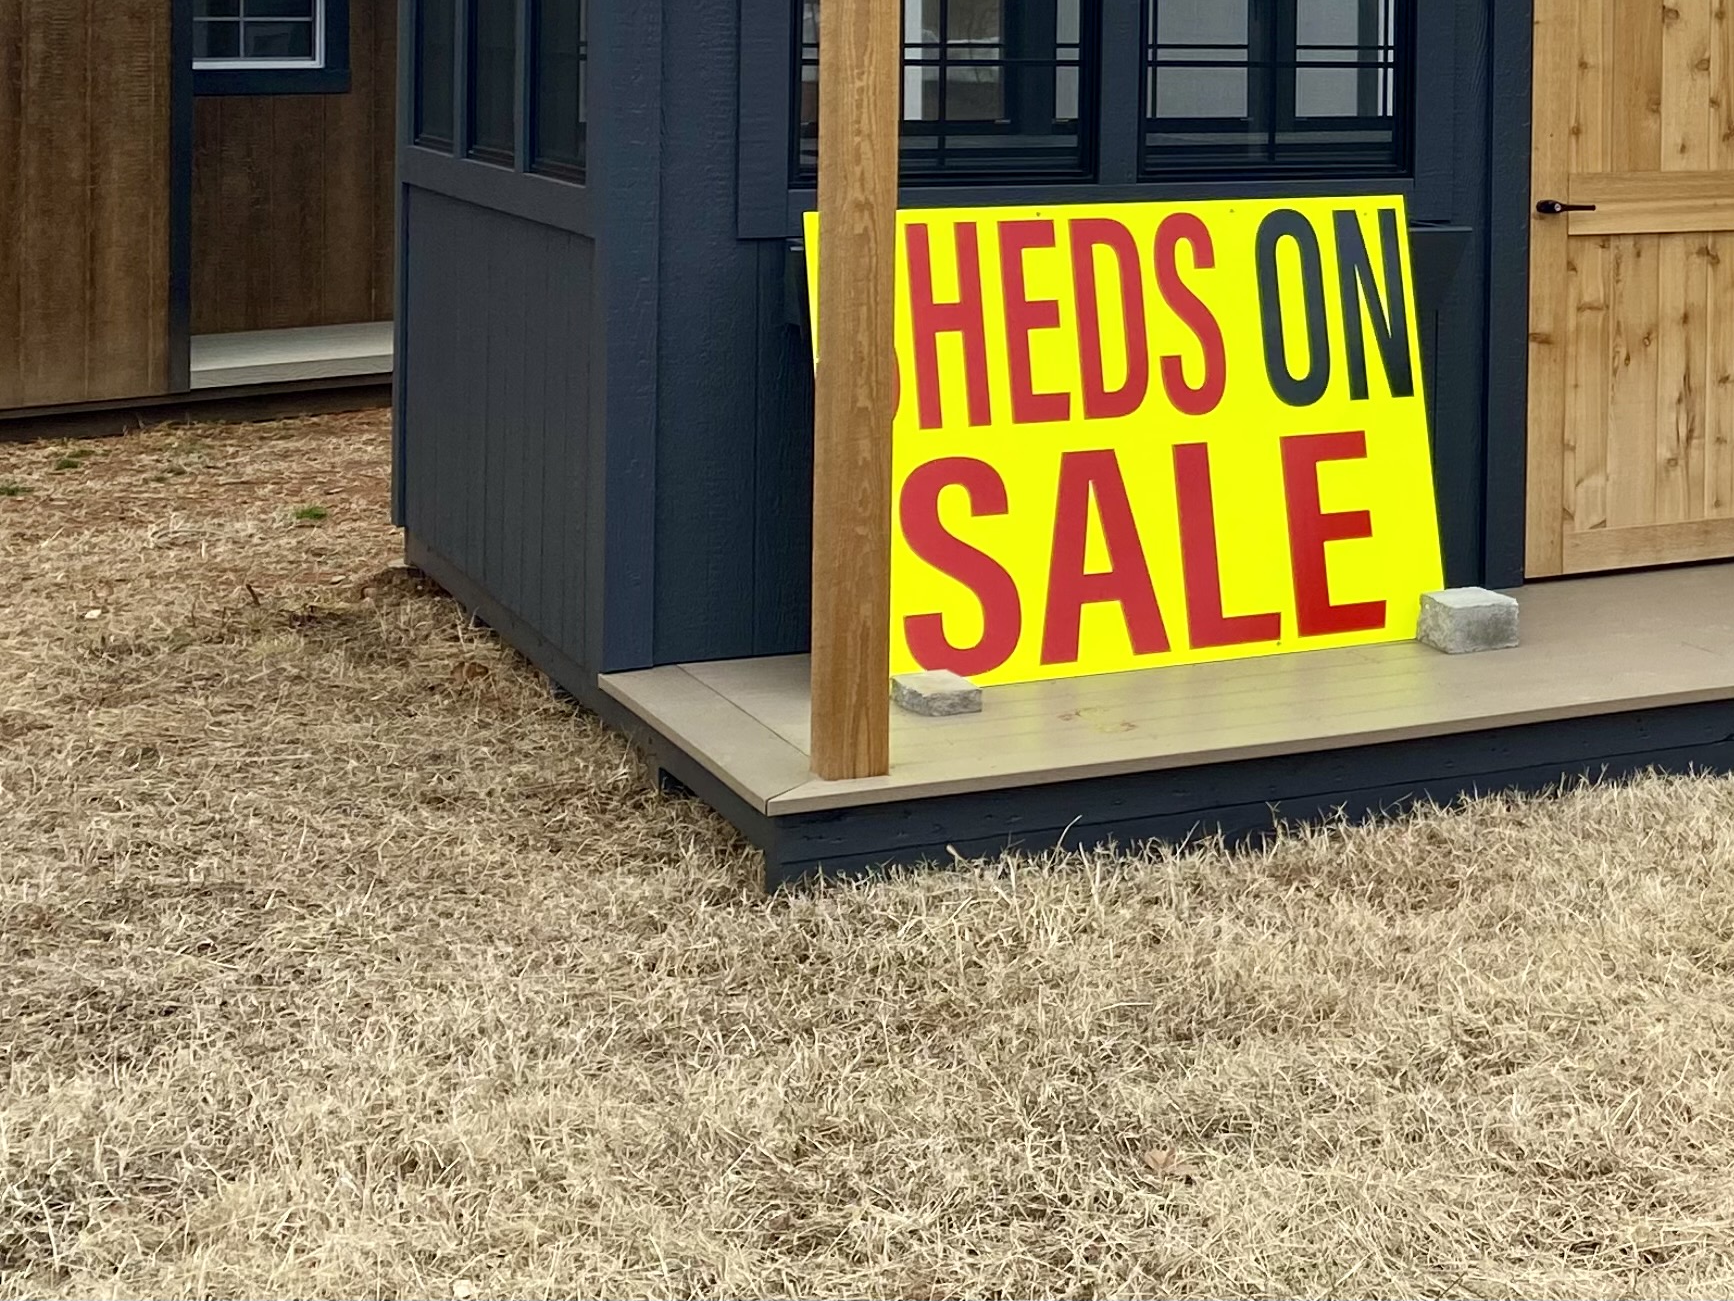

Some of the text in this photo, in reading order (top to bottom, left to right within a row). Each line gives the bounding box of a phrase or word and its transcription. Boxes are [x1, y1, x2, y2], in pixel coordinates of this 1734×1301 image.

[891, 208, 1415, 430] HEDS ON
[899, 430, 1387, 677] SALE
